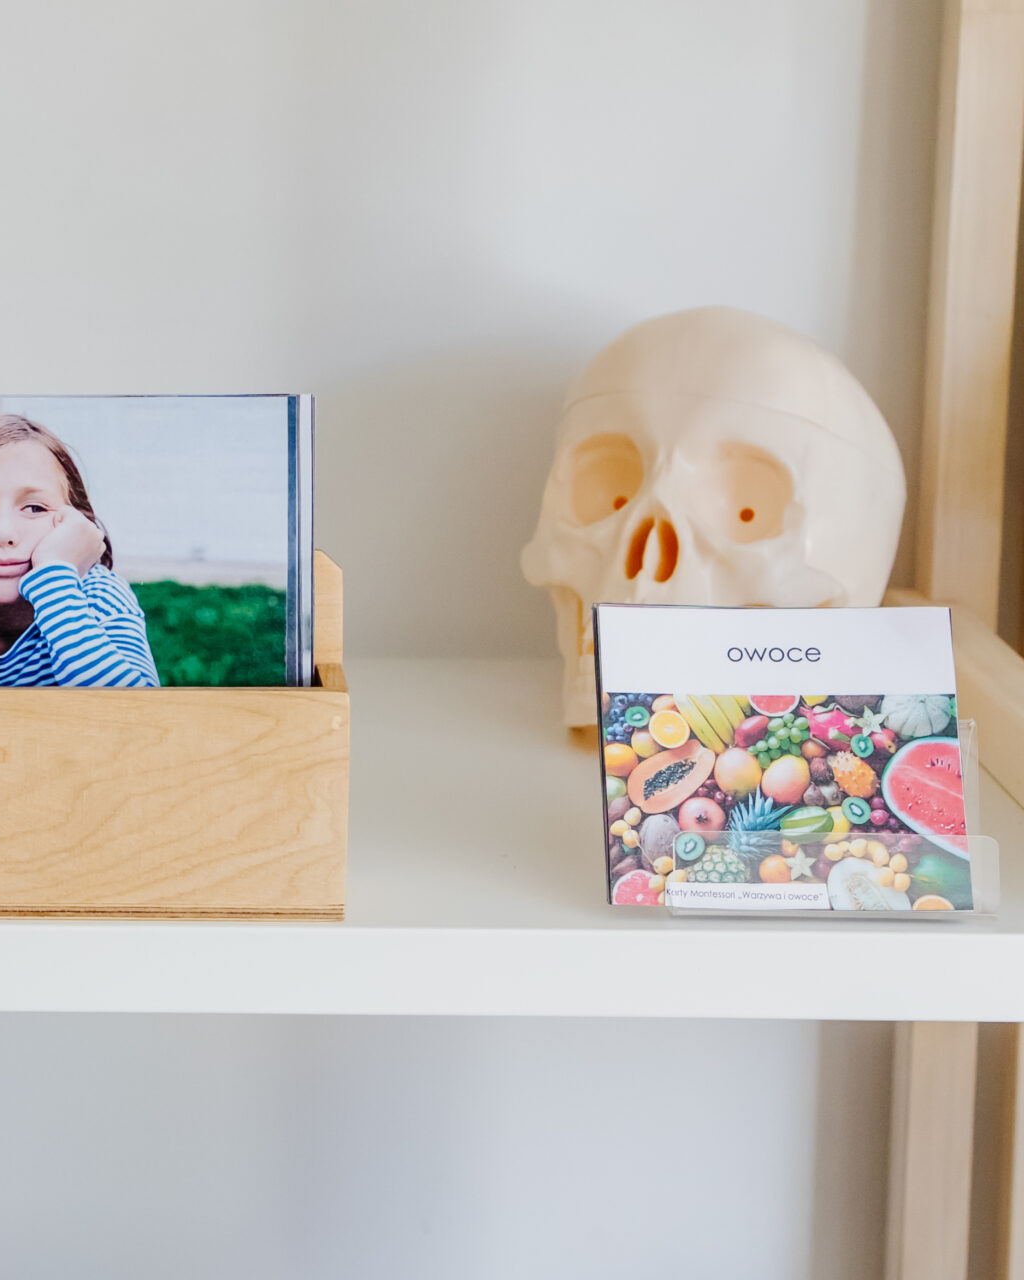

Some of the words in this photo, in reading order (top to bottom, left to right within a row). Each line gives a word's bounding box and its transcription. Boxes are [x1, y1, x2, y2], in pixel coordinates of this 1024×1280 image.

[726, 646, 822, 664] owoce
[665, 887, 688, 899] Karty
[690, 888, 736, 900] Montessori
